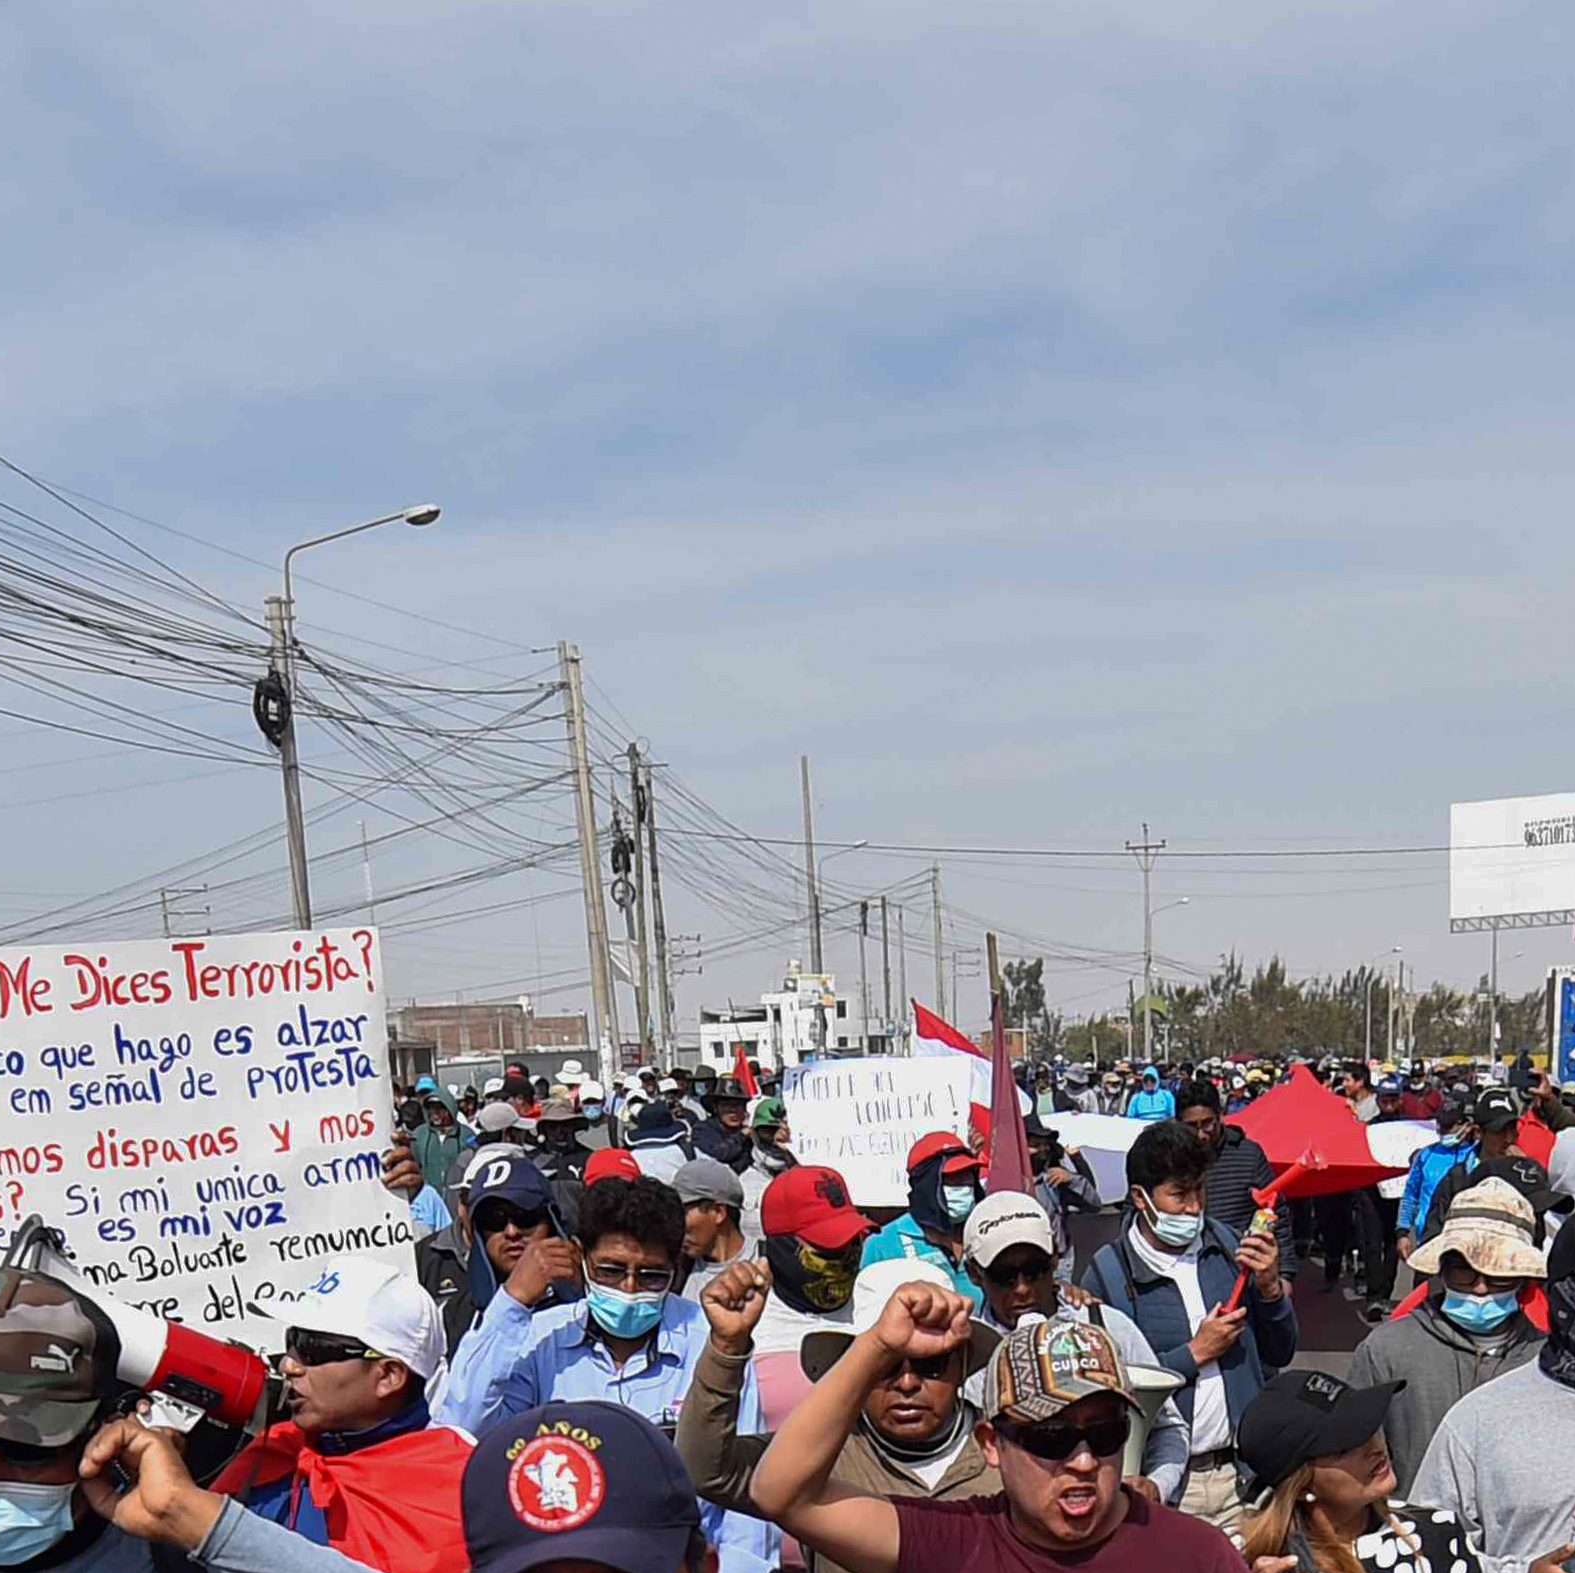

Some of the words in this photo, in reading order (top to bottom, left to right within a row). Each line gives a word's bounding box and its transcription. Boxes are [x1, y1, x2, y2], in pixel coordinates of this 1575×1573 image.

[64, 955, 172, 1010] Dices
[171, 930, 375, 1002] Terrorista?
[40, 1043, 96, 1081] que
[113, 1023, 192, 1073] hago
[213, 1025, 254, 1056] es
[277, 1004, 368, 1047] alzar
[180, 1066, 218, 1100] de
[86, 1126, 239, 1169] disparas
[65, 1184, 101, 1215] Si
[119, 1176, 170, 1214] mi
[304, 1151, 381, 1188] arm
[483, 1160, 512, 1189] D
[97, 1218, 136, 1242] es
[160, 1206, 212, 1238] mi
[223, 1201, 288, 1232] voz
[128, 1231, 248, 1282] Boluarte
[203, 1274, 245, 1323] del
[506, 1438, 526, 1461] 60
